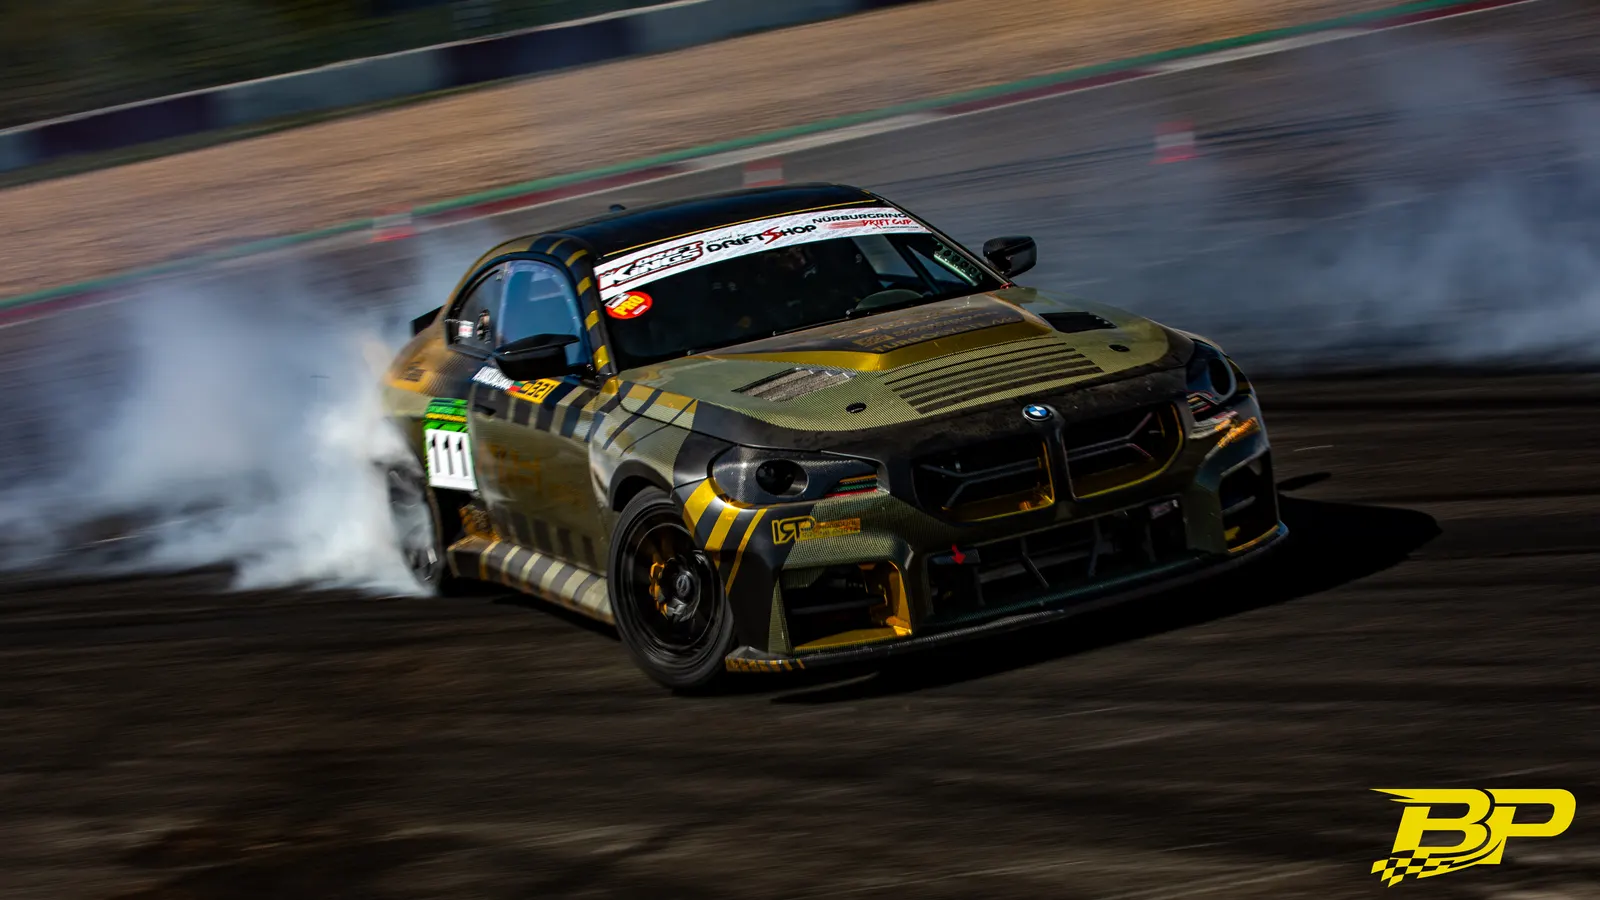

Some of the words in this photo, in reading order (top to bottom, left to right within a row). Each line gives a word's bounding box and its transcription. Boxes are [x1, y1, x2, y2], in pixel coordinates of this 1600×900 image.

[862, 219, 891, 229] DRIFT
[612, 295, 645, 317] PRO
[427, 433, 469, 478] 111
